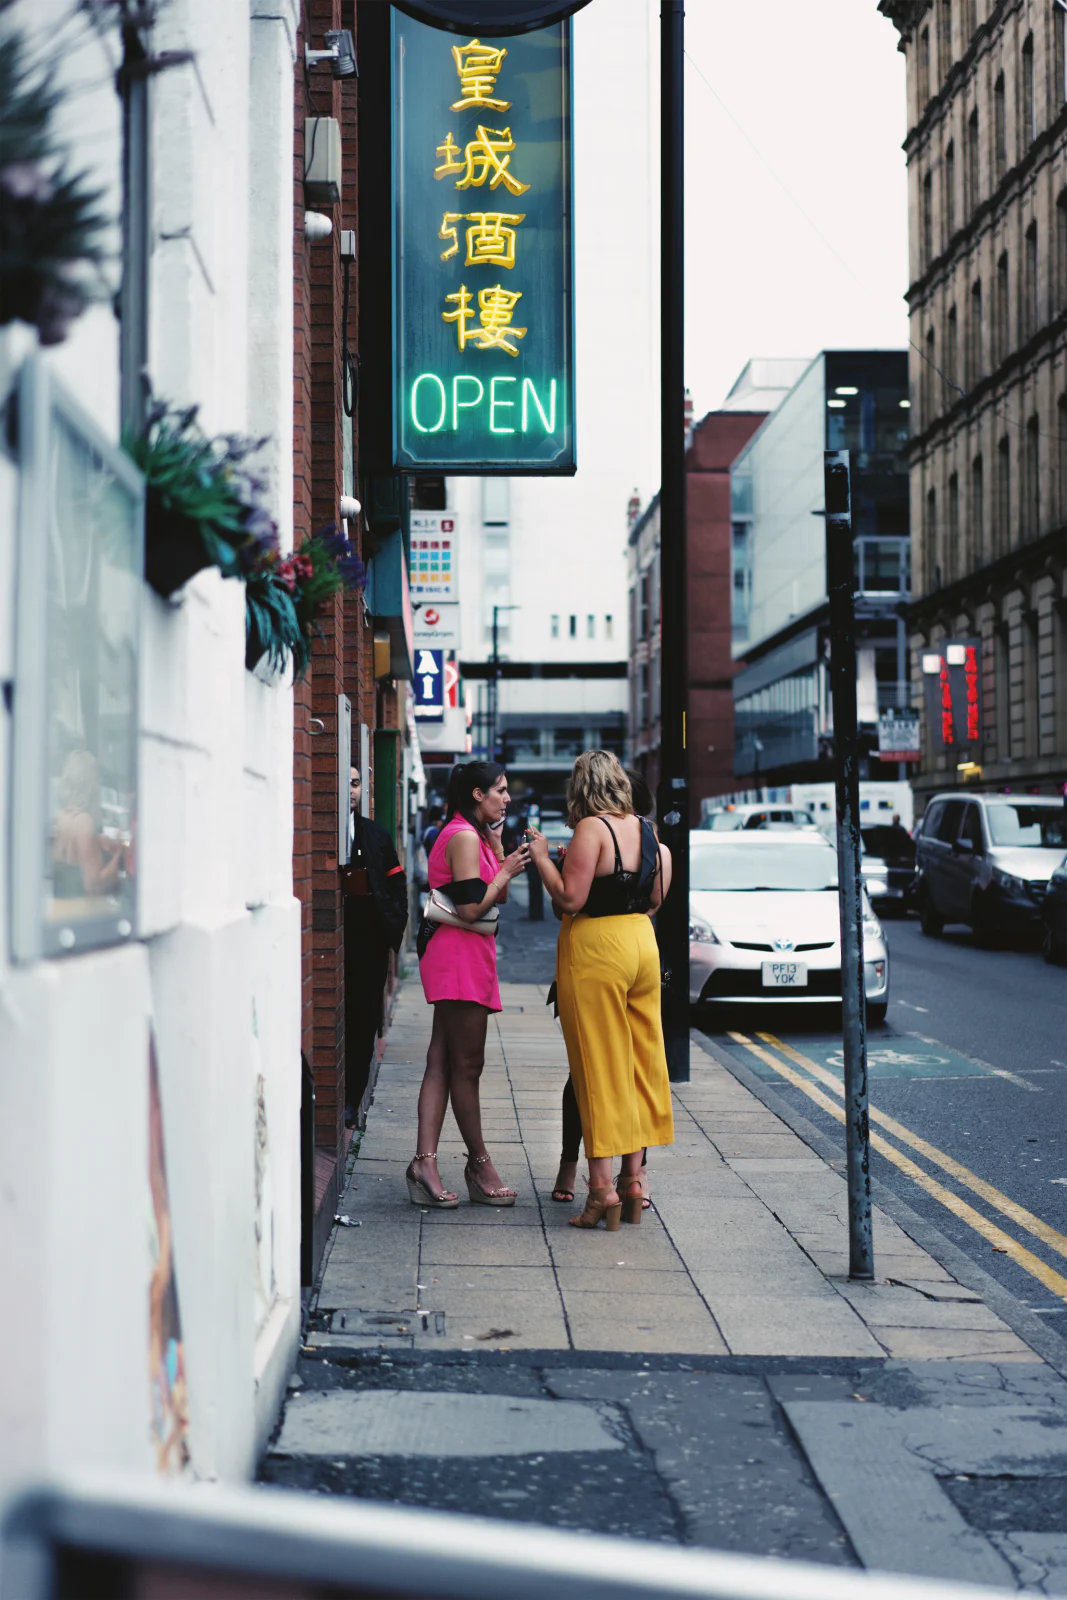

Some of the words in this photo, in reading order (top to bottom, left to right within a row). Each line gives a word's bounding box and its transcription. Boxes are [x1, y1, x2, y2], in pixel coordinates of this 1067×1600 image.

[434, 38, 531, 356] 皇城酒樓
[410, 373, 557, 434] OPEN
[413, 631, 454, 639] oneyGram
[772, 963, 797, 973] PF13
[774, 974, 795, 984] YOK
